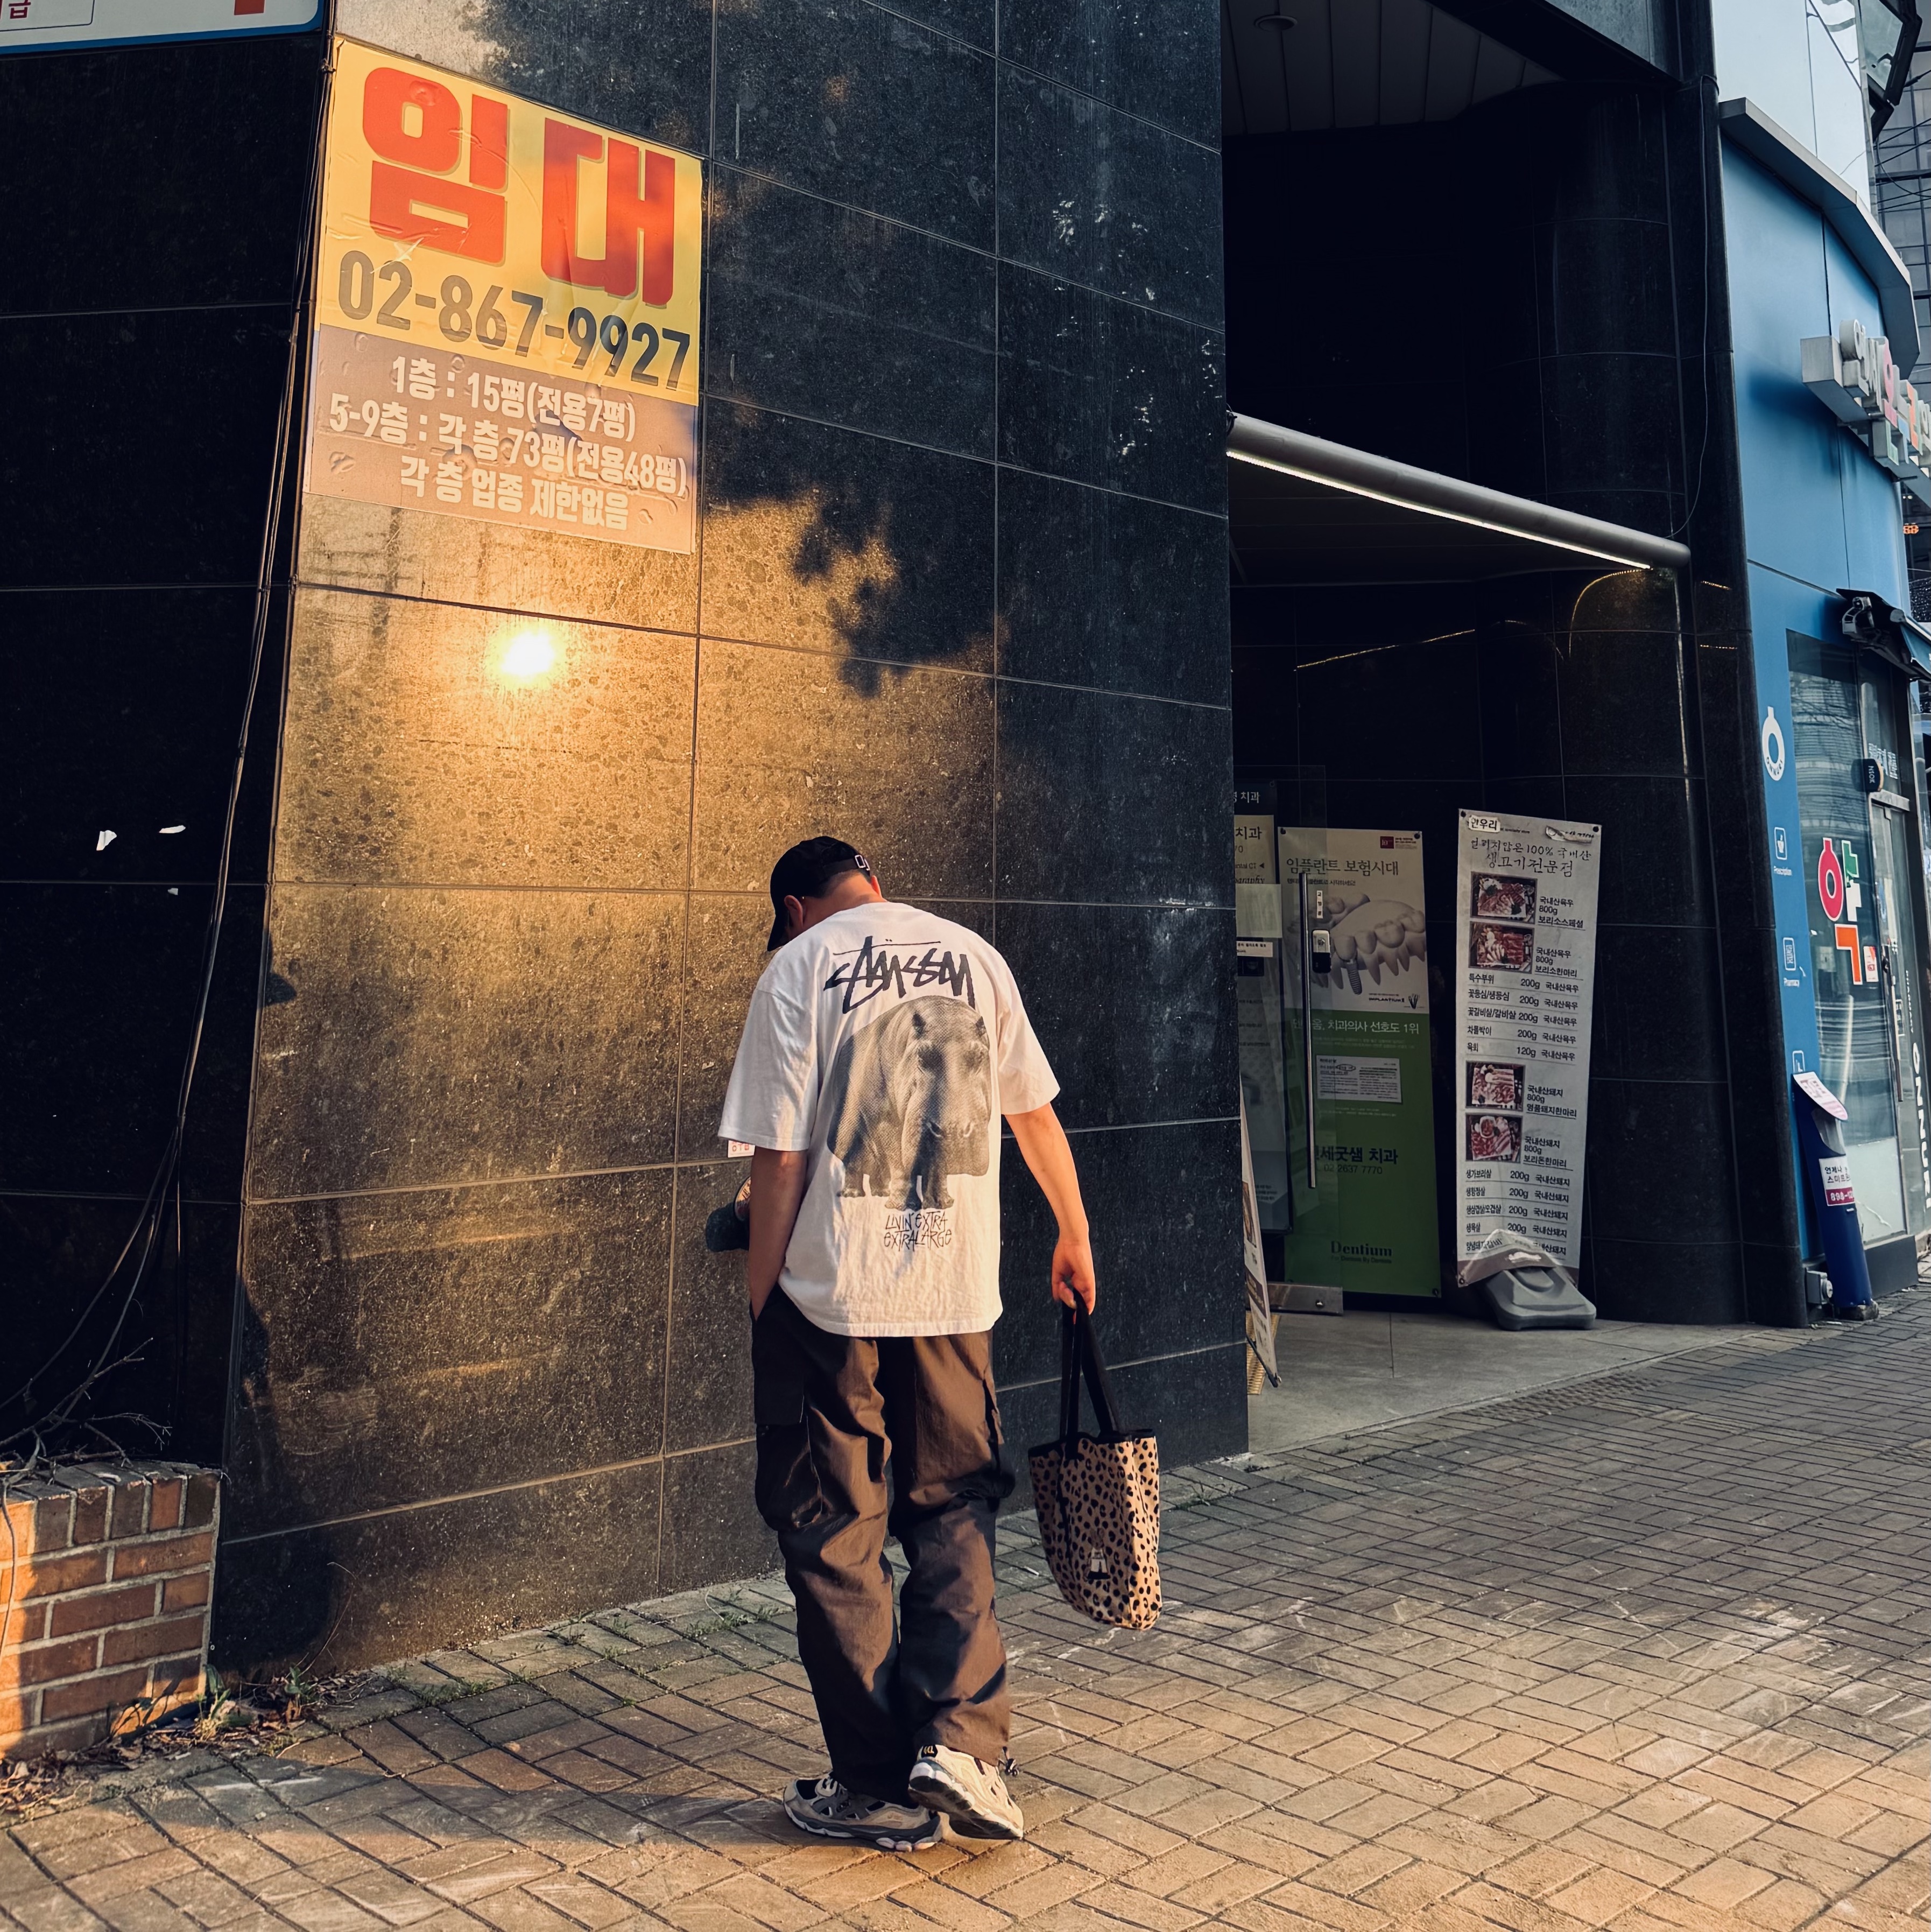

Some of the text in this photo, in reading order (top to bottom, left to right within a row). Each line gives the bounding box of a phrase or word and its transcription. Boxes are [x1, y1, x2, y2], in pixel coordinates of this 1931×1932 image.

[363, 67, 676, 308] 임대
[339, 250, 690, 391] 02-867-9927
[392, 356, 436, 401] 1층
[467, 373, 636, 442] 15평(전용7평)
[329, 393, 409, 445] 5-9층
[438, 413, 467, 455] 각
[472, 420, 500, 462] 층
[507, 426, 689, 498] 73평(전용48평)
[400, 455, 629, 531] 각 층 업종 제한없음
[1241, 791, 1260, 803] 치과
[1236, 826, 1263, 840] 치과
[1527, 844, 1553, 856] 100%
[1558, 847, 1591, 861] 국내산
[1287, 858, 1399, 876] 임플란트 보험시대
[1486, 852, 1573, 877] 생고기전문점
[1520, 978, 1541, 989] 200g
[1519, 995, 1539, 1007] 200g
[1518, 1012, 1539, 1023] 200g
[1517, 1029, 1538, 1041] 200g
[1516, 1046, 1537, 1058] 120g
[1369, 1147, 1398, 1165] 치과
[1337, 1164, 1358, 1174] 2637
[1362, 1165, 1383, 1175] 7770
[1510, 1170, 1530, 1183] 200g
[1509, 1188, 1529, 1199] 200g
[1509, 1205, 1528, 1217] 200g
[1507, 1223, 1527, 1234] 200g
[1331, 1240, 1392, 1256] Dentium
